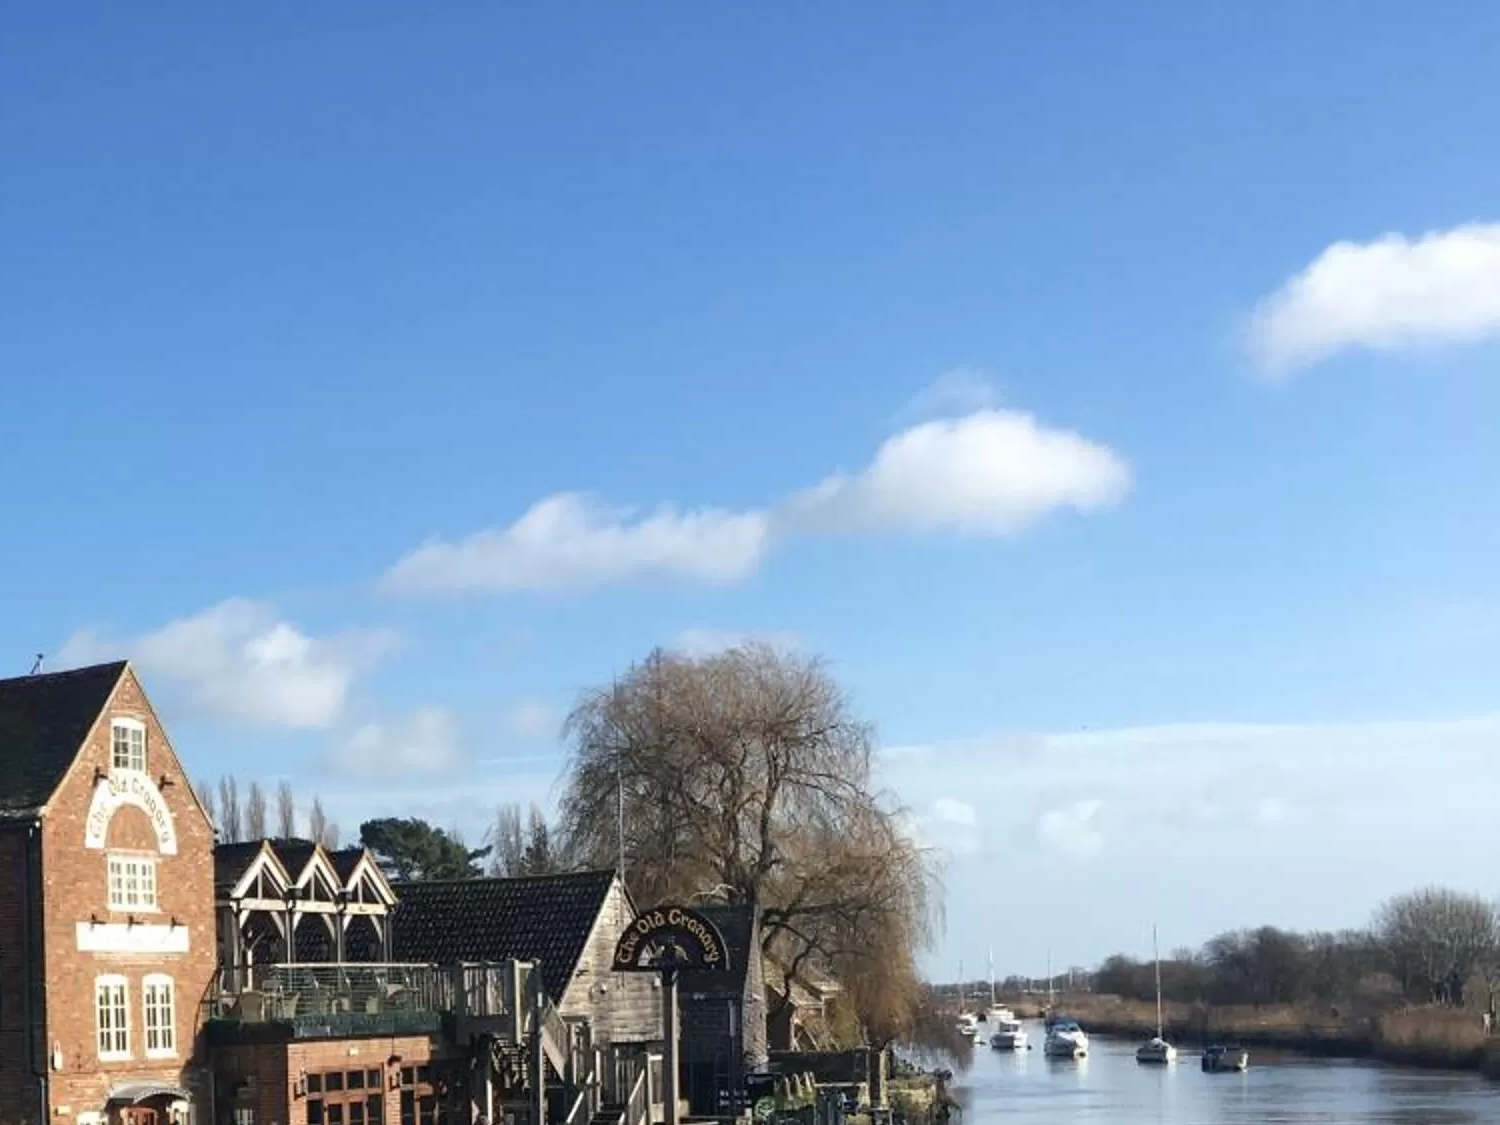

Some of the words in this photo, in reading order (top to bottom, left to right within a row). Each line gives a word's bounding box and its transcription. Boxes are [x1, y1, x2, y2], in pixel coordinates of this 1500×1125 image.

[615, 931, 641, 963] The
[636, 910, 666, 934] Old
[668, 908, 721, 963] Granary
